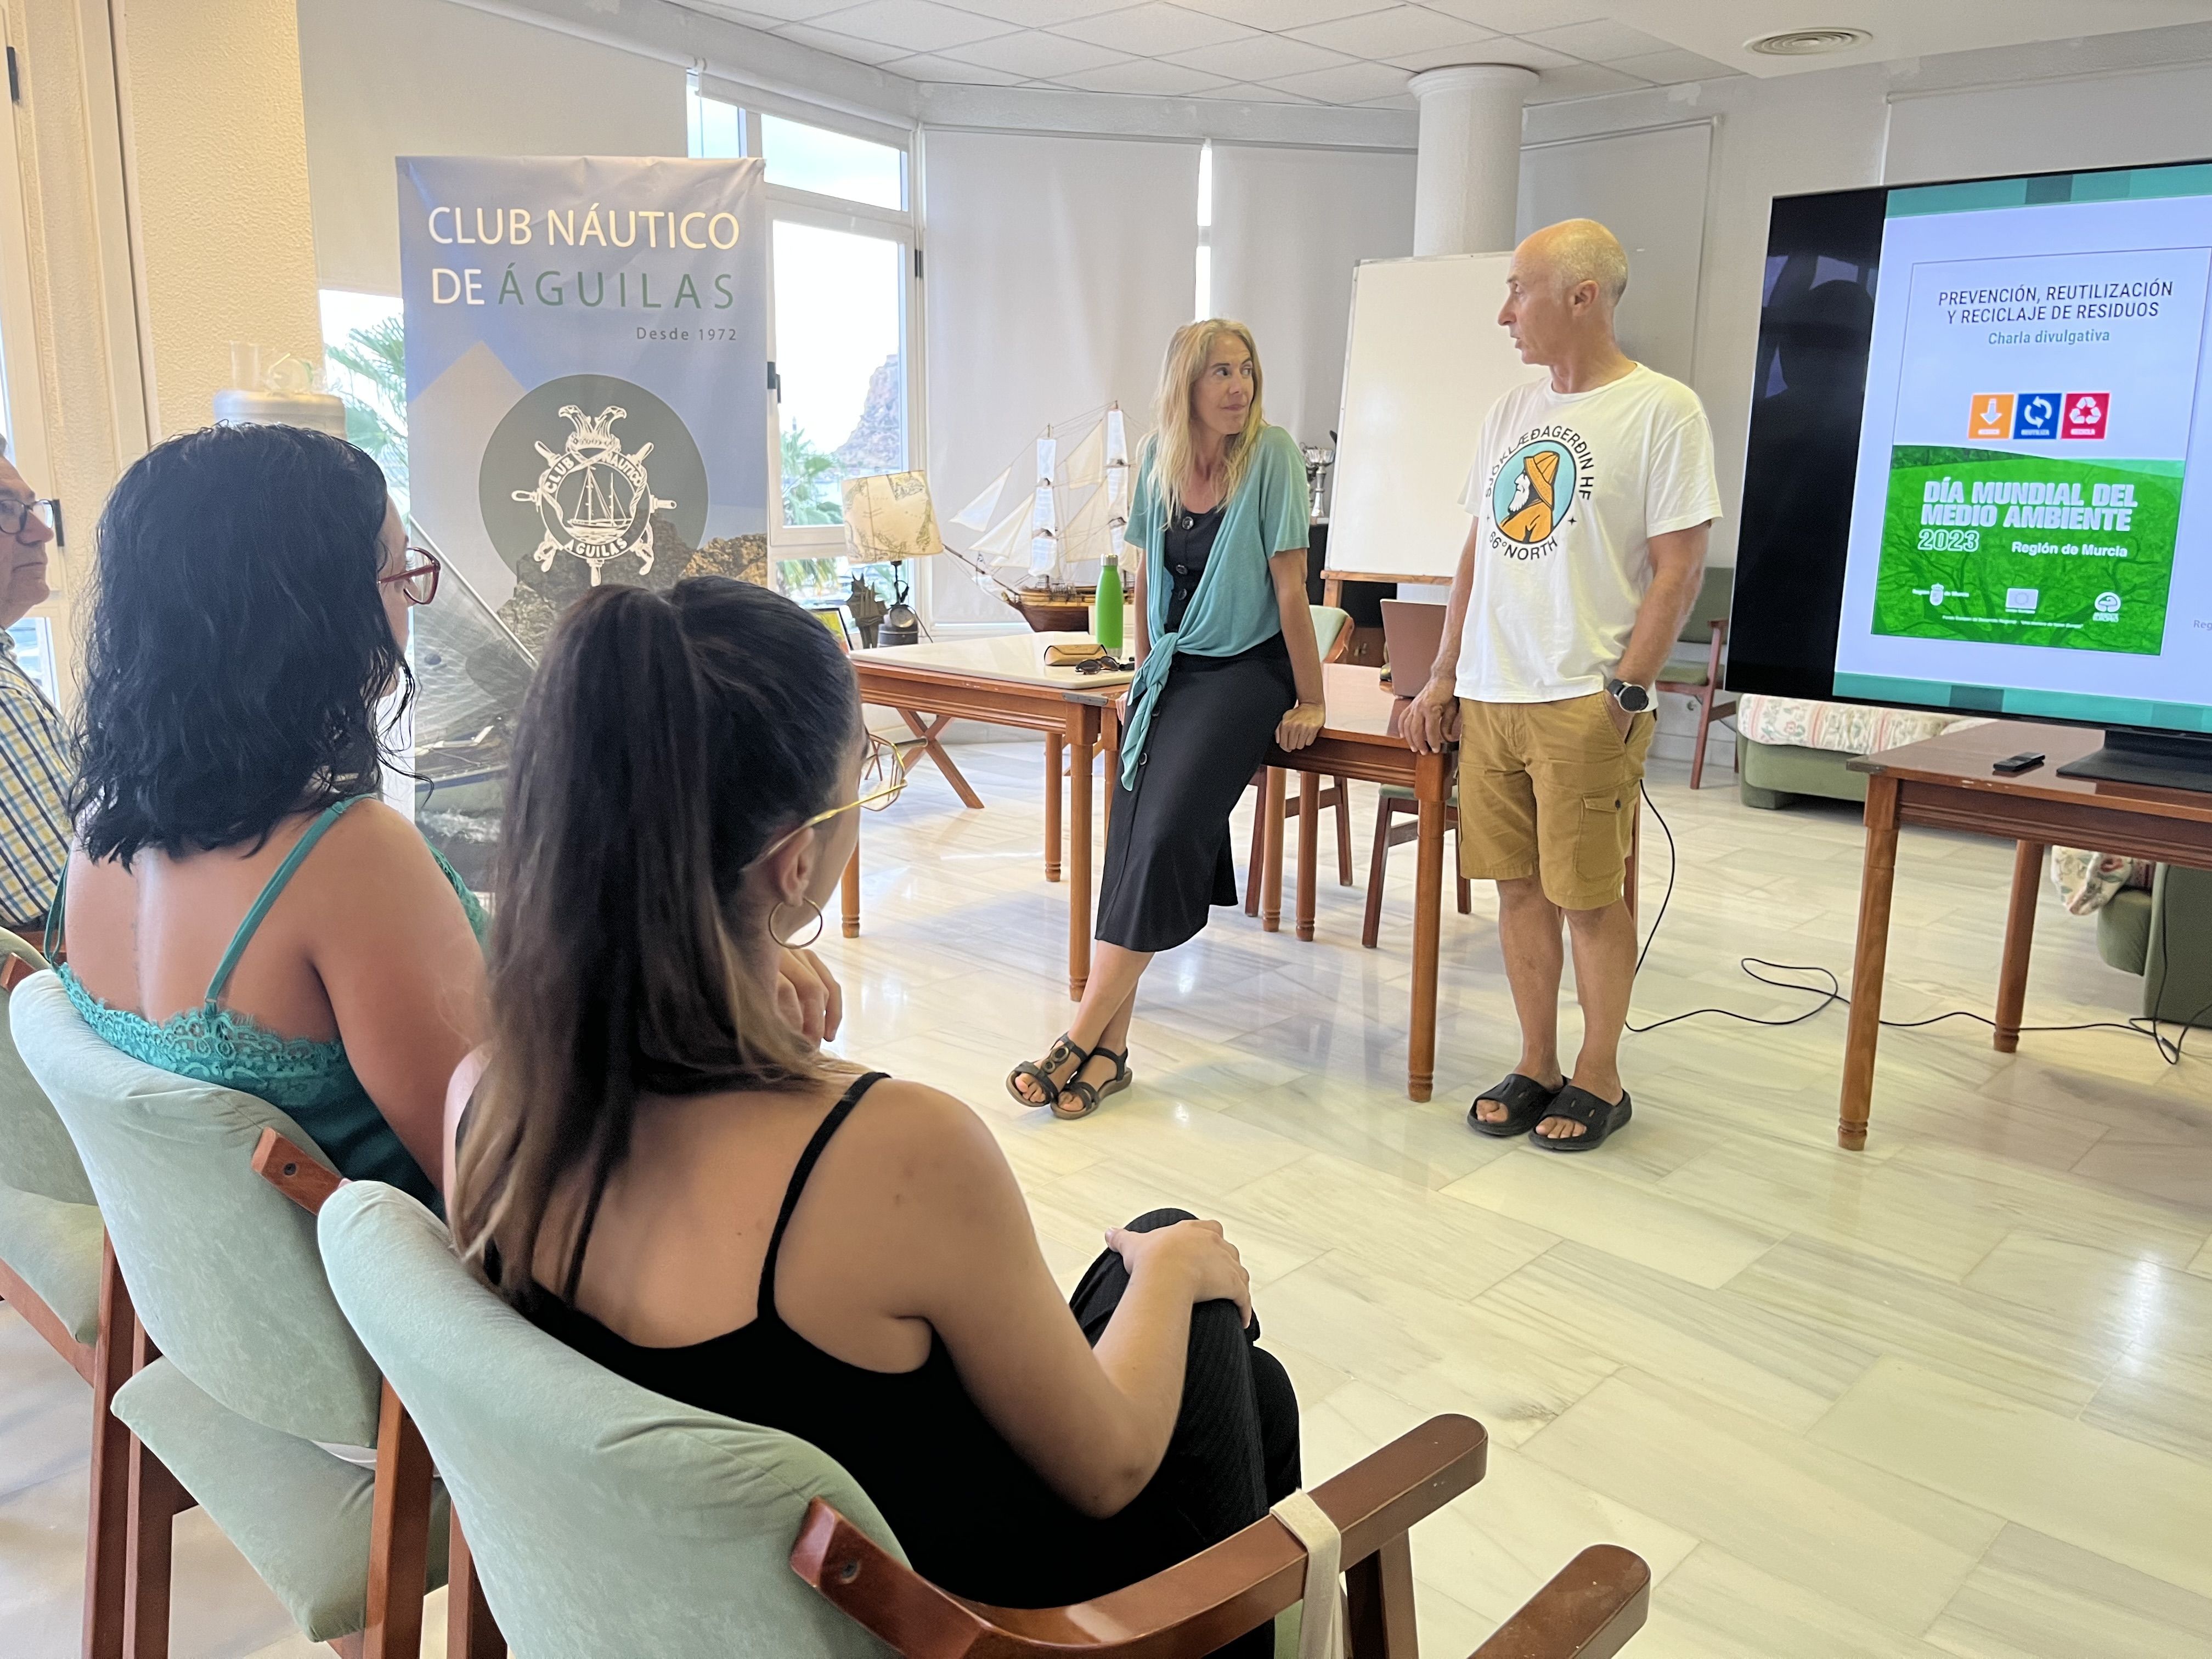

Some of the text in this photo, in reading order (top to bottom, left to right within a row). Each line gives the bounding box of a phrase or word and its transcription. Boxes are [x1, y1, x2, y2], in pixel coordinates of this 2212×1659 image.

[429, 203, 740, 249] CLUB NÁUTICO
[432, 263, 733, 309] DE ÁGUILAS
[1939, 278, 2173, 306] PREVENCIÓN, REUTILIZACIÓN
[1948, 302, 2159, 324] Y RECICLAJE DE RESIDUOS
[637, 327, 737, 341] Desde 1972
[1989, 329, 2110, 345] Charla divulgativa
[545, 457, 574, 494] CLUB
[1579, 477, 1594, 500] HF
[1923, 477, 2137, 507] DÍA MUNDIAL DEL
[1921, 504, 2133, 532] MEDIO AMBIENTE
[1917, 530, 1979, 551] 2023
[2011, 541, 2128, 557] Región de Murcia
